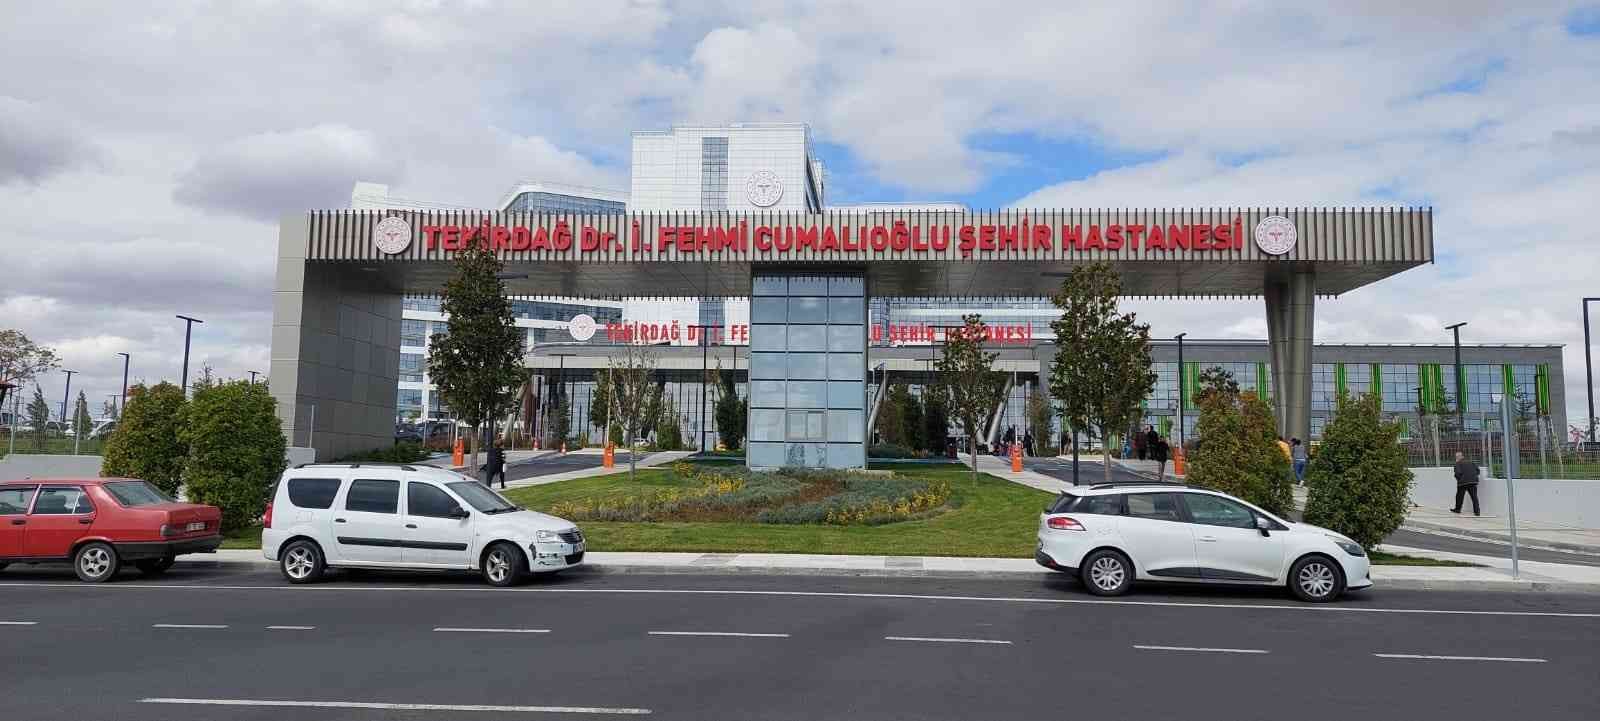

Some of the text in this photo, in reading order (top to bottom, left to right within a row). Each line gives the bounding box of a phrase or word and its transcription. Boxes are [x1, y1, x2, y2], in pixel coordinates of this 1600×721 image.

[423, 219, 572, 251] TEKİRDAĞ
[581, 225, 623, 252] Dr.
[632, 220, 652, 252] İ.
[658, 218, 748, 251] FEHMİ
[754, 221, 950, 251] CUMALIOĞLU
[958, 216, 1053, 257] ŞEHİR
[1062, 217, 1243, 251] HASTANESİ
[607, 320, 680, 341] TEKİRDAĞ
